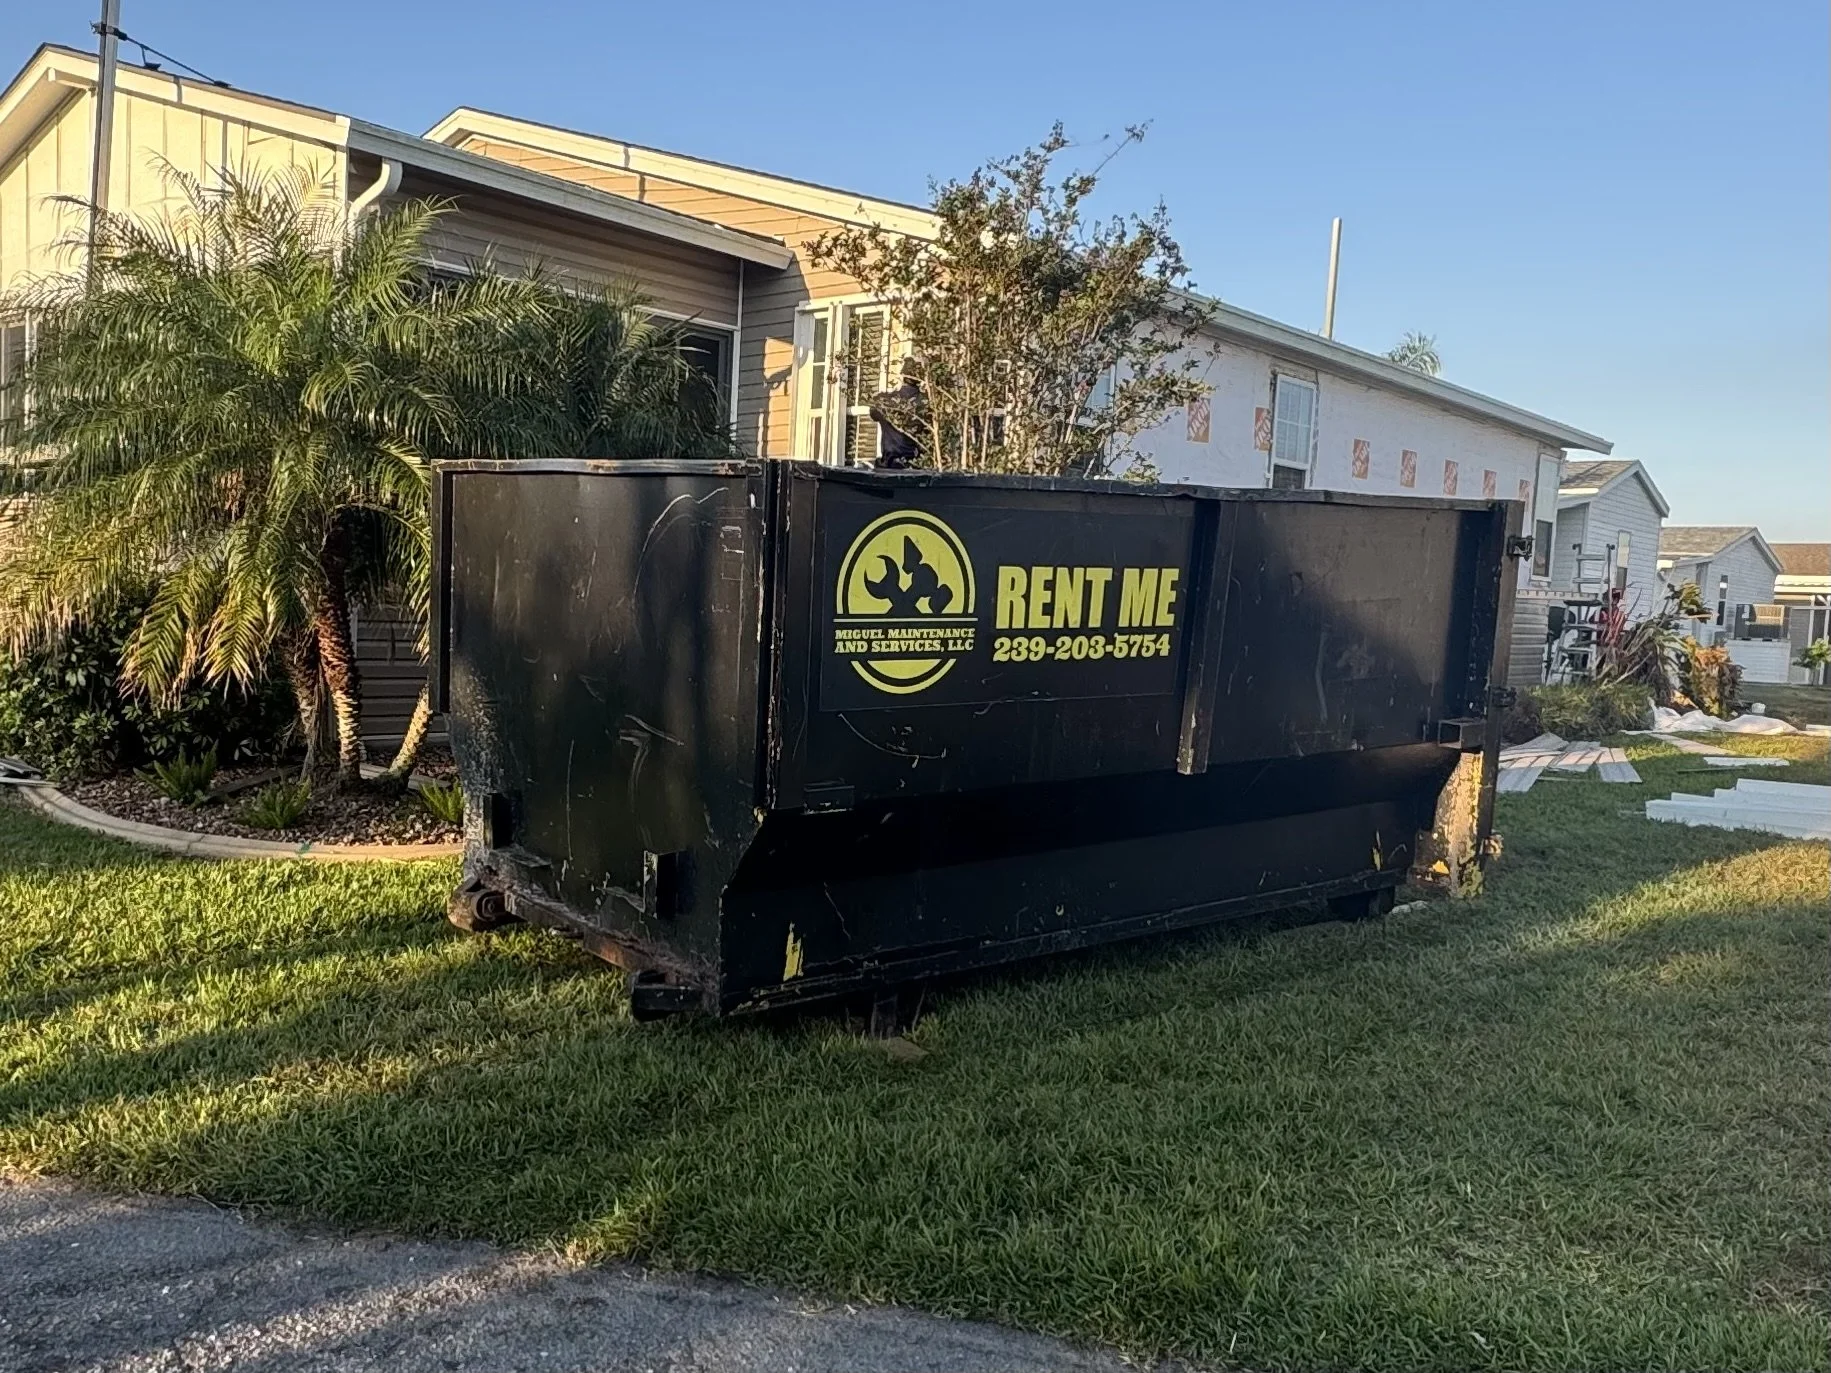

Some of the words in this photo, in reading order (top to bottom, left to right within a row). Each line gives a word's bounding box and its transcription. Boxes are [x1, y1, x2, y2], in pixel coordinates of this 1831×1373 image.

[995, 565, 1113, 629] RENT
[1118, 567, 1180, 628] ME
[835, 629, 885, 639] MIGUEL
[887, 628, 976, 639] MAINTENANCE
[834, 640, 868, 653] AND
[871, 639, 945, 653] SERVICES,
[947, 639, 975, 651] LLC
[993, 633, 1171, 662] 239-203-5754
